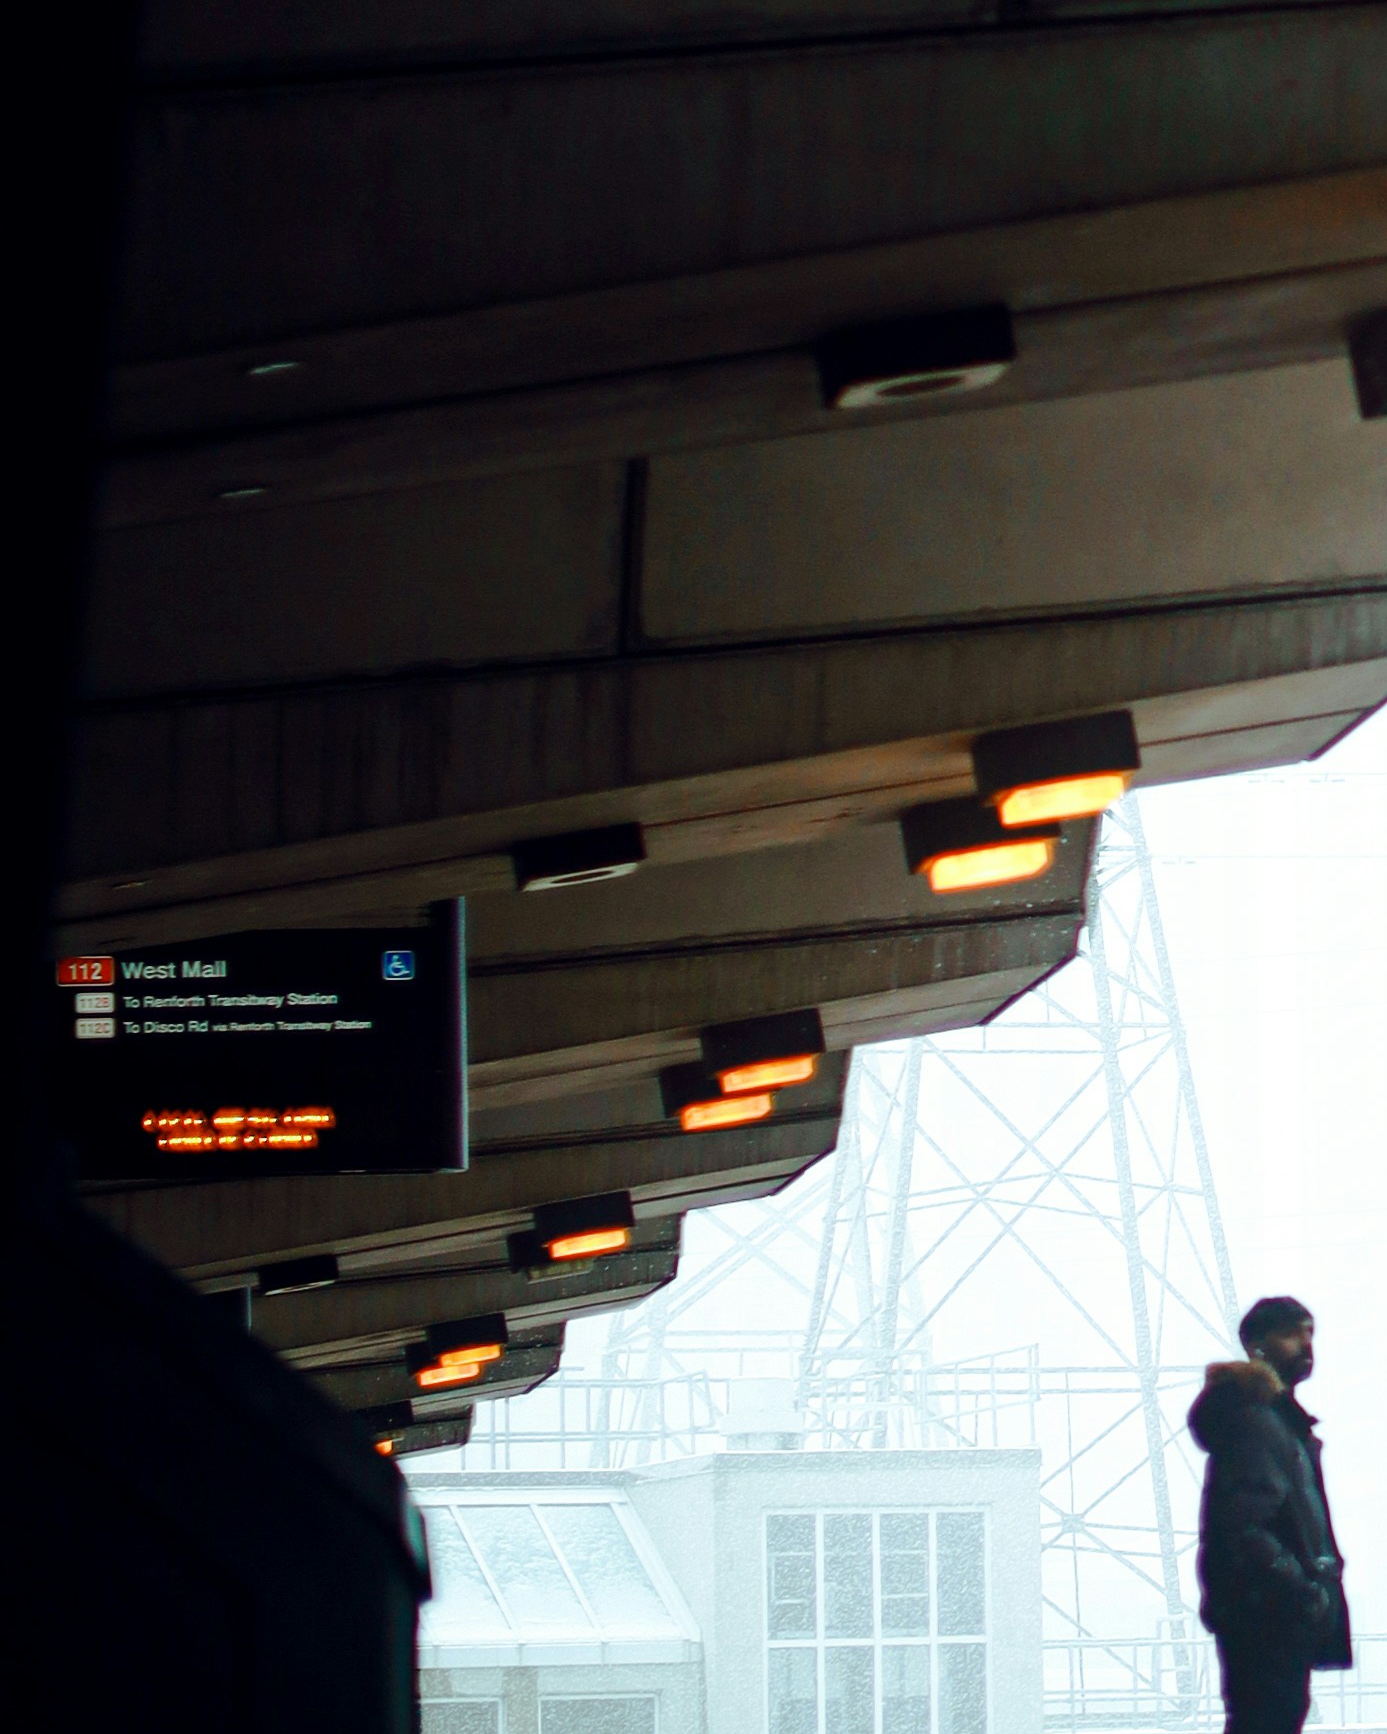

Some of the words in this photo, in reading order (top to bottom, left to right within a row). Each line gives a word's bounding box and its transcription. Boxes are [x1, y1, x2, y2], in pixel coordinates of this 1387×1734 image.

[69, 963, 103, 980] 112
[121, 961, 176, 980] West
[182, 960, 227, 978] Mall
[123, 996, 140, 1009] To
[143, 995, 206, 1008] Renforth
[208, 994, 285, 1008] Transitway
[287, 993, 338, 1005] Station
[123, 1021, 140, 1034] To
[144, 1021, 185, 1034] Disco
[188, 1020, 209, 1033] Rd
[334, 1019, 372, 1030] Station
